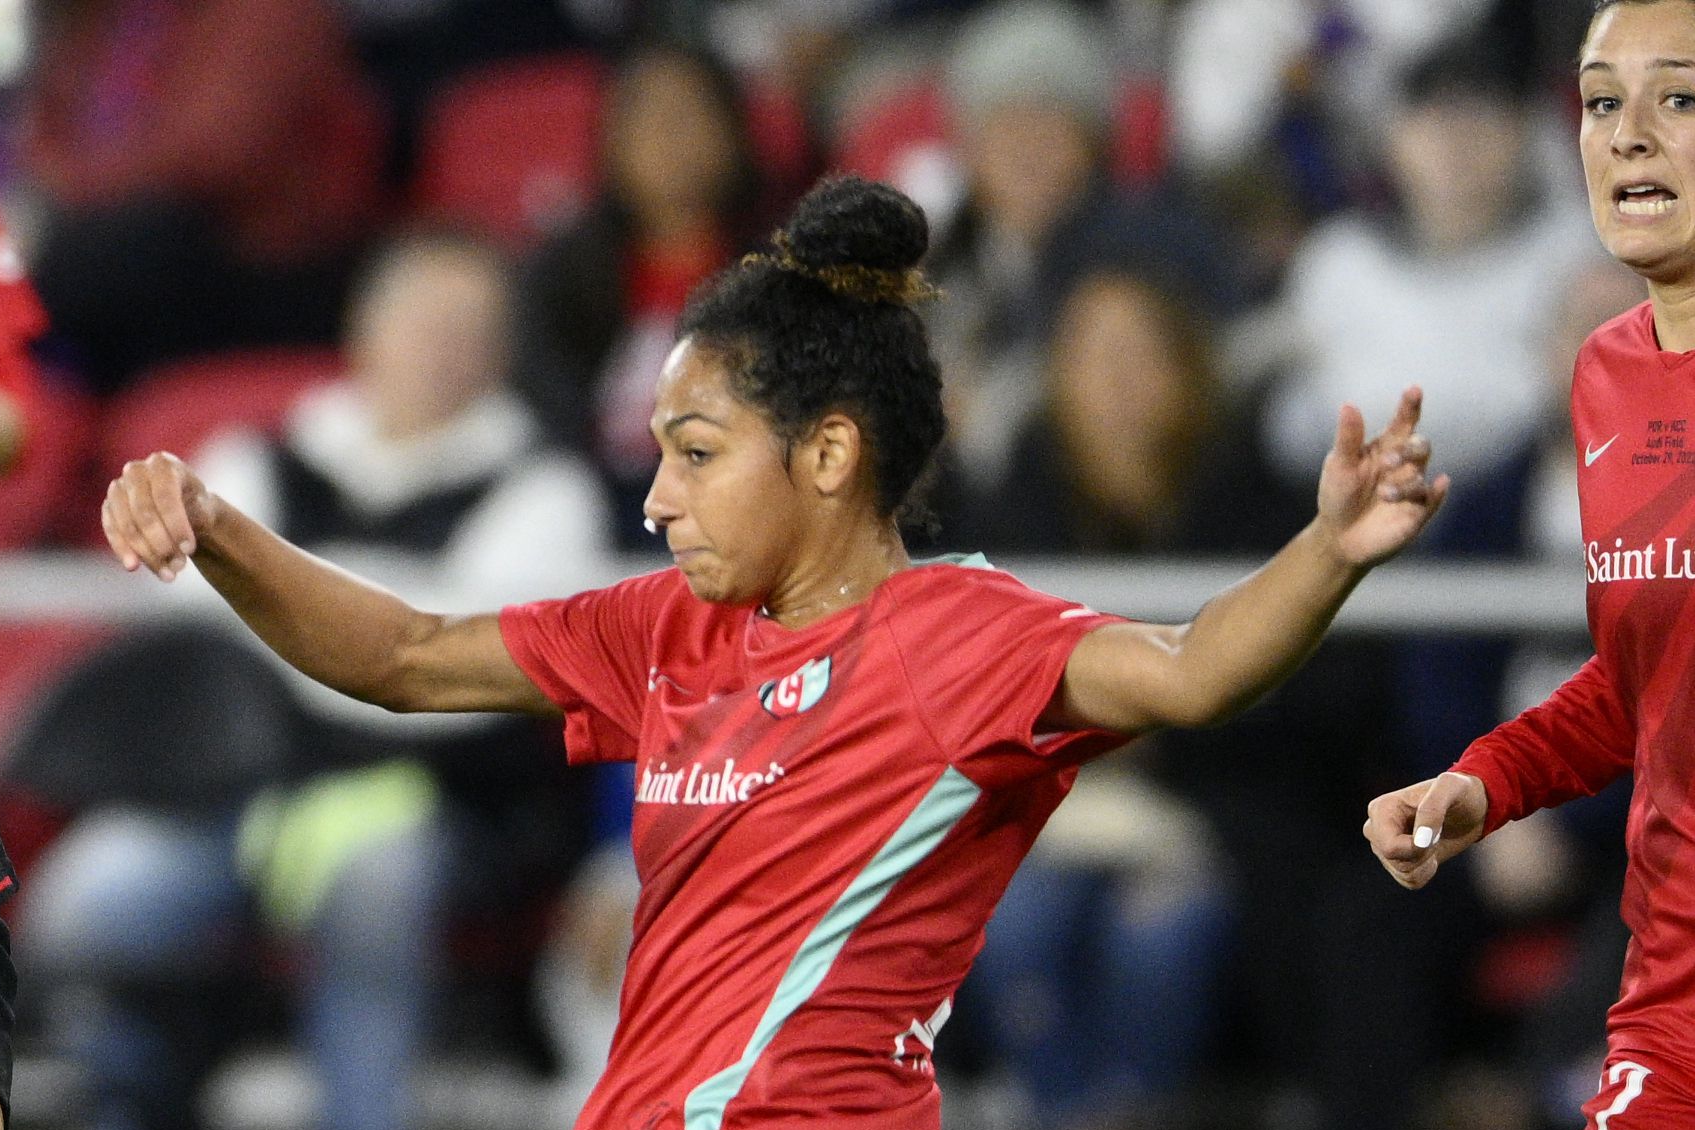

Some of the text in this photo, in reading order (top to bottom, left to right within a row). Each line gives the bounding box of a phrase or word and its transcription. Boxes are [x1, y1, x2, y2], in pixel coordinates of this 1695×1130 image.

[1647, 420, 1663, 433] POR
[1646, 435, 1685, 449] Audi Field
[1632, 452, 1661, 465] October
[1587, 536, 1656, 584] Saint
